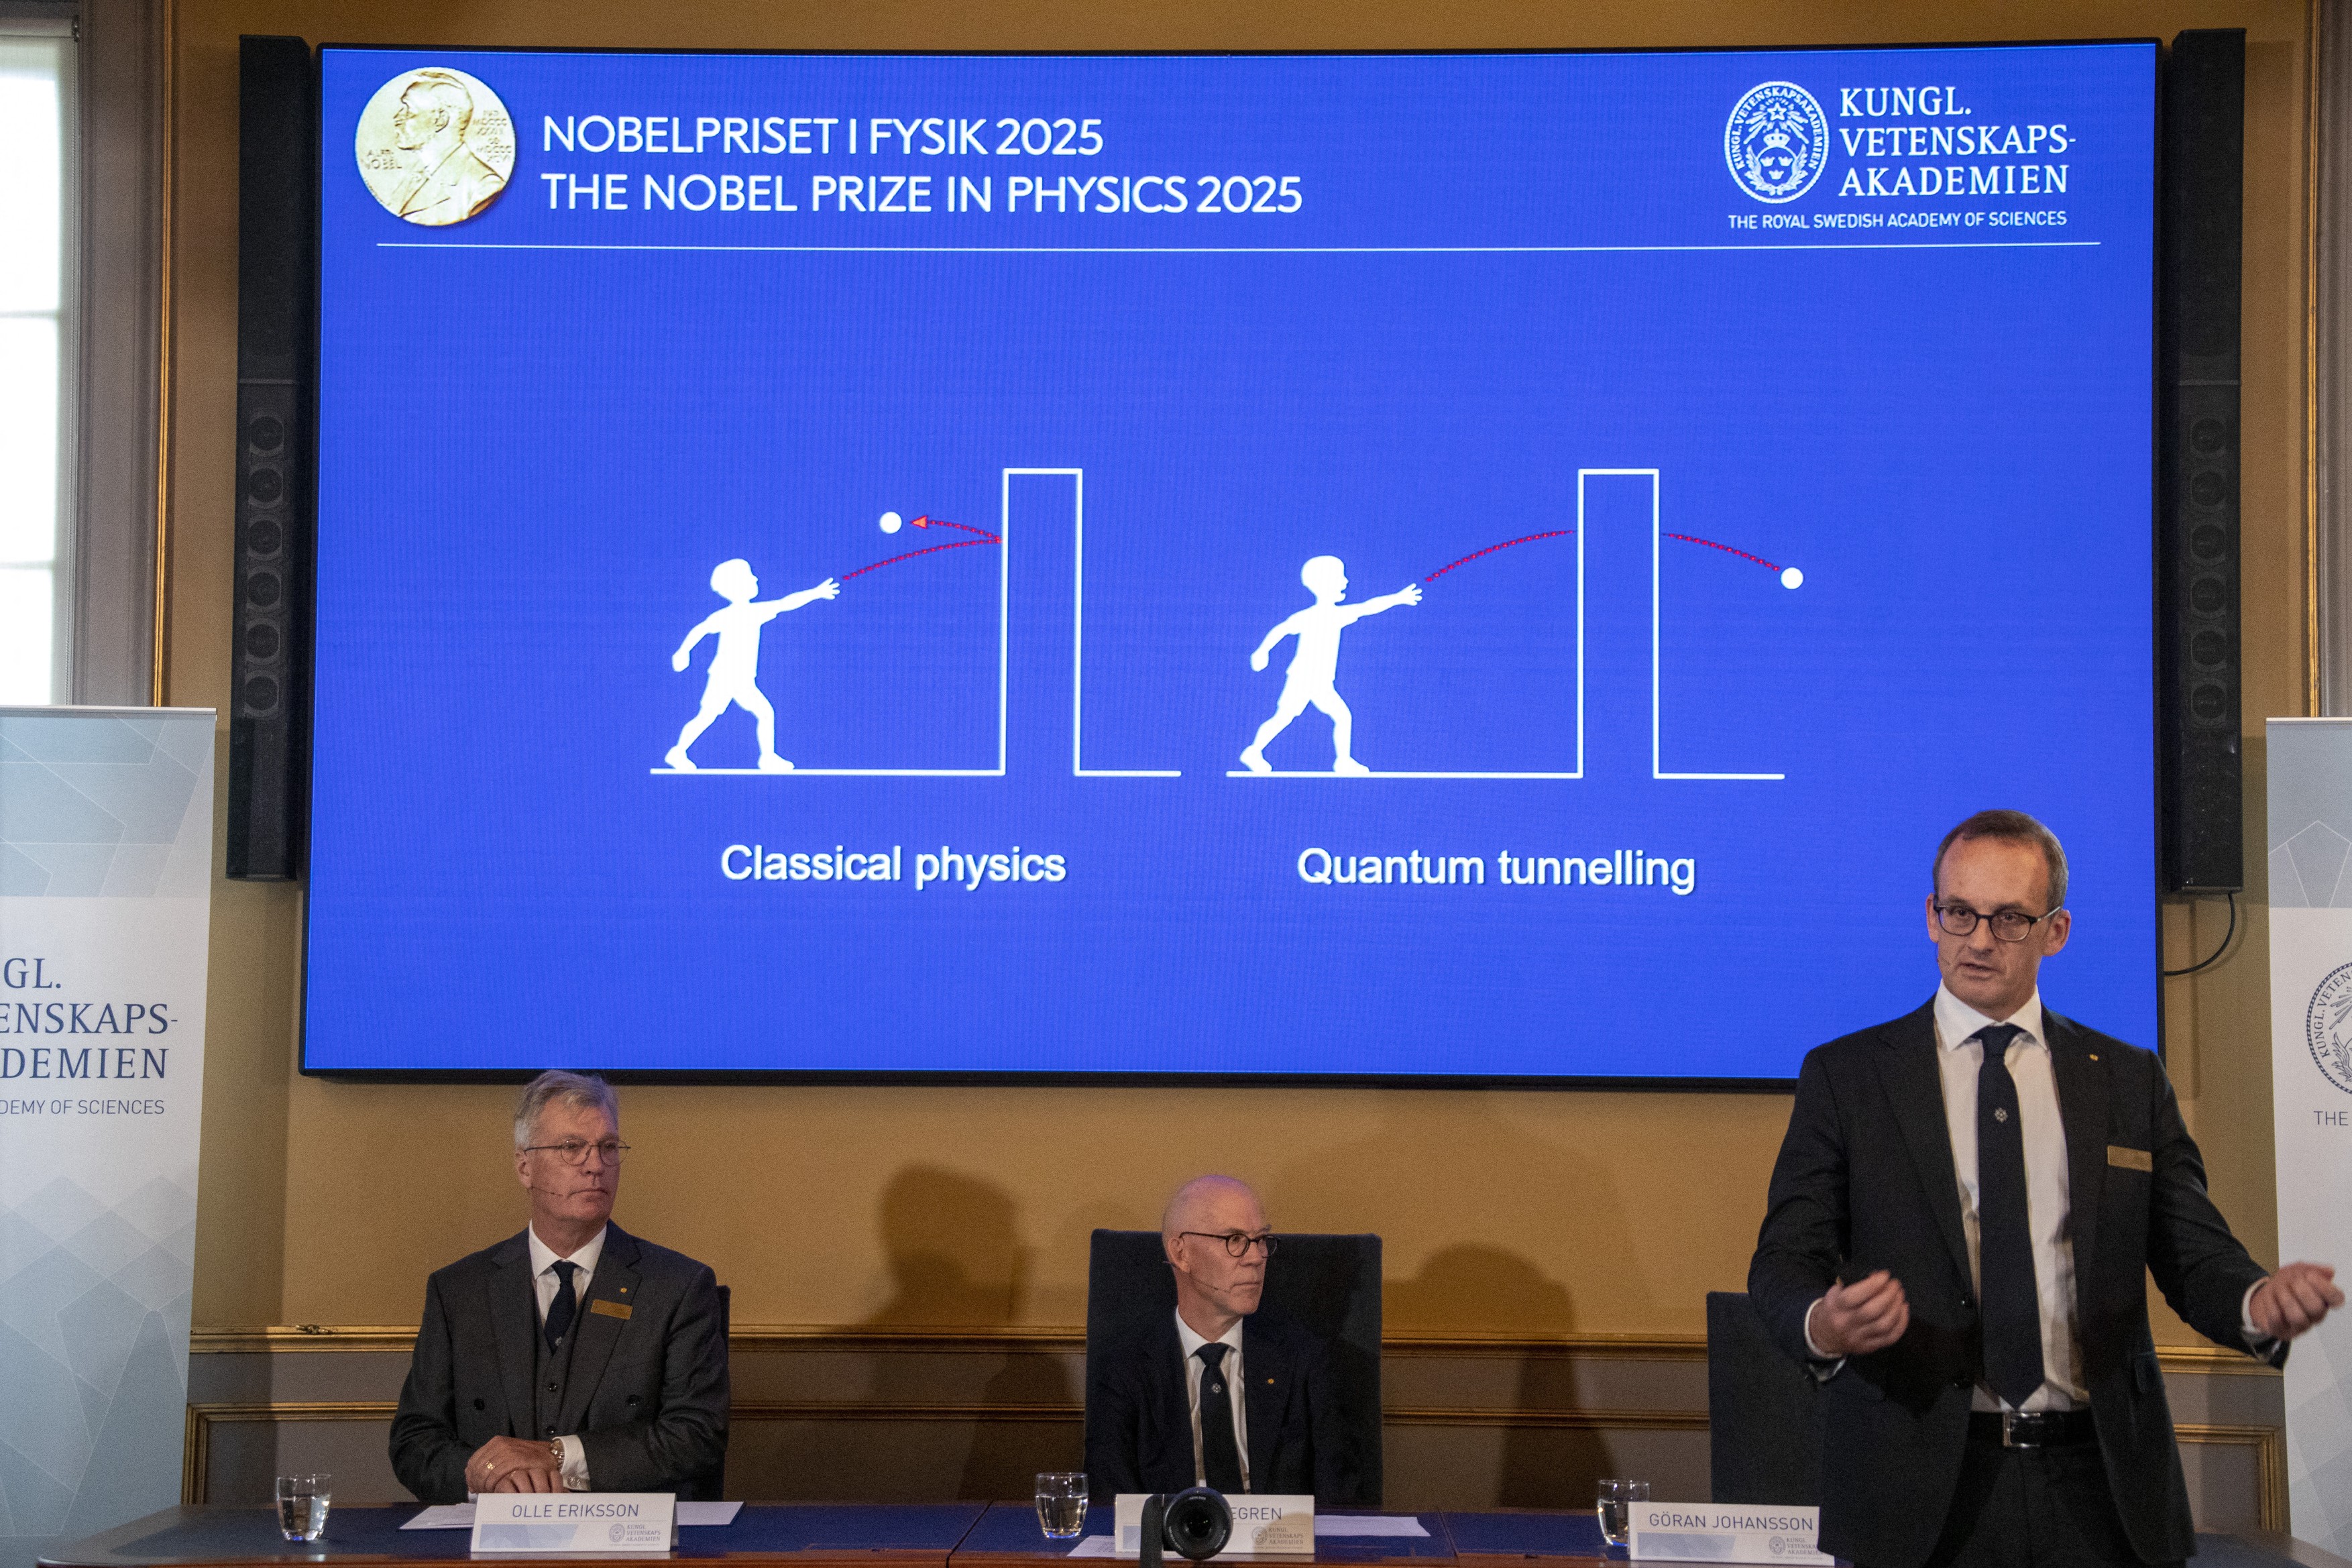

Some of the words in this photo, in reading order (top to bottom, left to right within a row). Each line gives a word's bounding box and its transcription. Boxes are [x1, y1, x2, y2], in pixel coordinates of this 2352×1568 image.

[1840, 86, 1972, 117] KUNGL.
[544, 115, 839, 154] NOBELPRISET
[848, 118, 857, 154] I
[871, 117, 989, 155] FYSIK
[996, 117, 1103, 156] 2025
[1838, 124, 2076, 157] VETENSKAPS-
[541, 173, 628, 210] THE
[644, 174, 798, 211] NOBEL
[812, 175, 932, 212] PRIZE
[948, 176, 991, 213] IN
[1009, 175, 1188, 213] PHYSICS
[1196, 175, 1302, 213] 2025
[1838, 164, 2069, 197] AKADEMIEN
[1728, 215, 1758, 229] THE
[1762, 214, 1809, 229] ROYAL
[1813, 213, 1883, 229] SWEDISH
[1887, 212, 1961, 228] ACADEMY
[1964, 212, 1985, 227] OF
[1989, 211, 2068, 227] SCIENCES
[721, 844, 901, 881] Classical
[915, 845, 1066, 891] physics
[1298, 847, 1484, 885] Quantum
[1497, 849, 1695, 895] tunnelling
[3, 958, 61, 989] GL.
[2314, 1009, 2330, 1058] KUNGL.
[51, 1100, 73, 1114] OF
[78, 1099, 165, 1115] SCIENCES
[2314, 1111, 2349, 1126] THE
[512, 1504, 553, 1518] OLLE
[558, 1504, 639, 1518] ERIKSSON
[1649, 1511, 1707, 1528] GÖRAN
[1712, 1516, 1813, 1531] JOHANSSON
